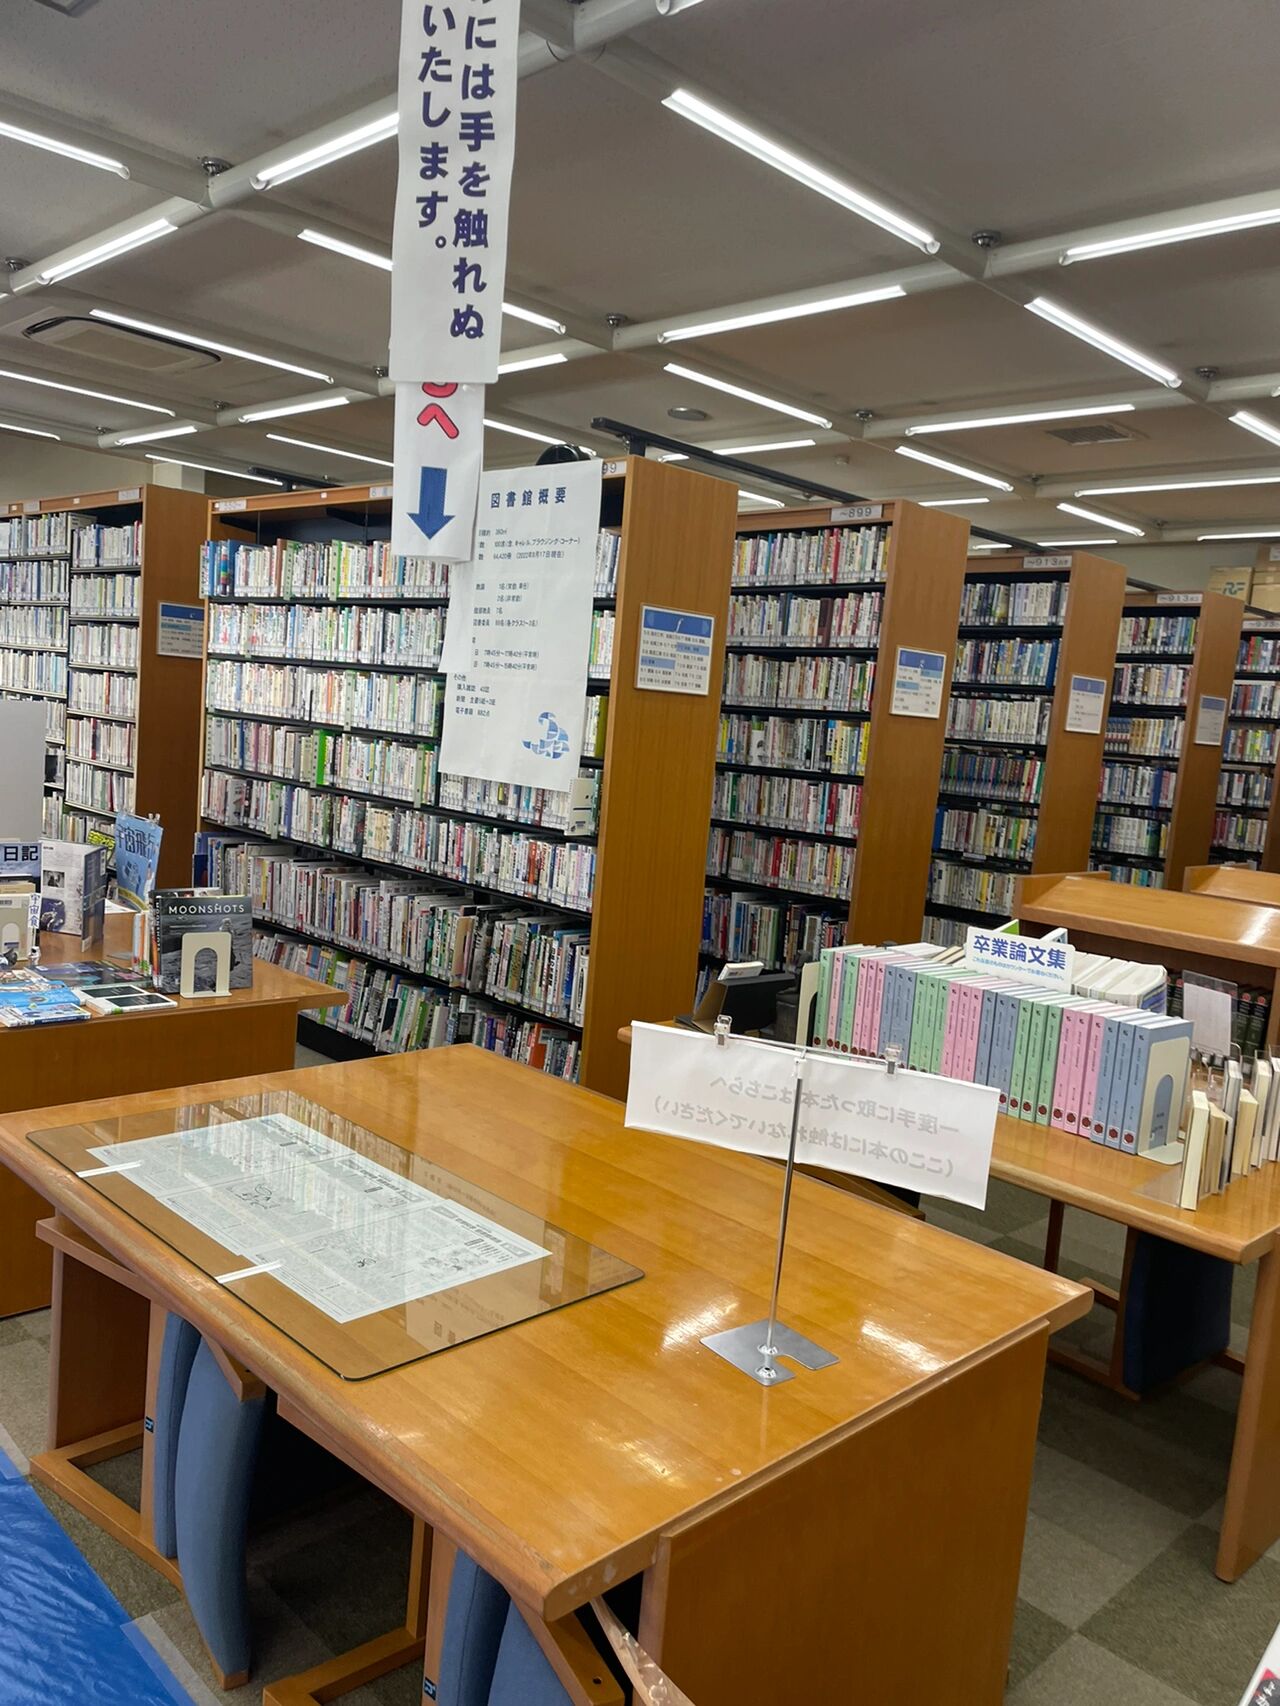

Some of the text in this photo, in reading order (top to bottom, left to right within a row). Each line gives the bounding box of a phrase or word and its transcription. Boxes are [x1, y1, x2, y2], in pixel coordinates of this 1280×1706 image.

[416, 4, 456, 249] いたします。
[449, 0, 497, 339] には手を触れぬ
[490, 486, 567, 508] 図書館概要
[4, 846, 38, 861] 日記
[168, 903, 245, 914] MOONSHOTS
[973, 934, 1067, 970] 卒業論文集
